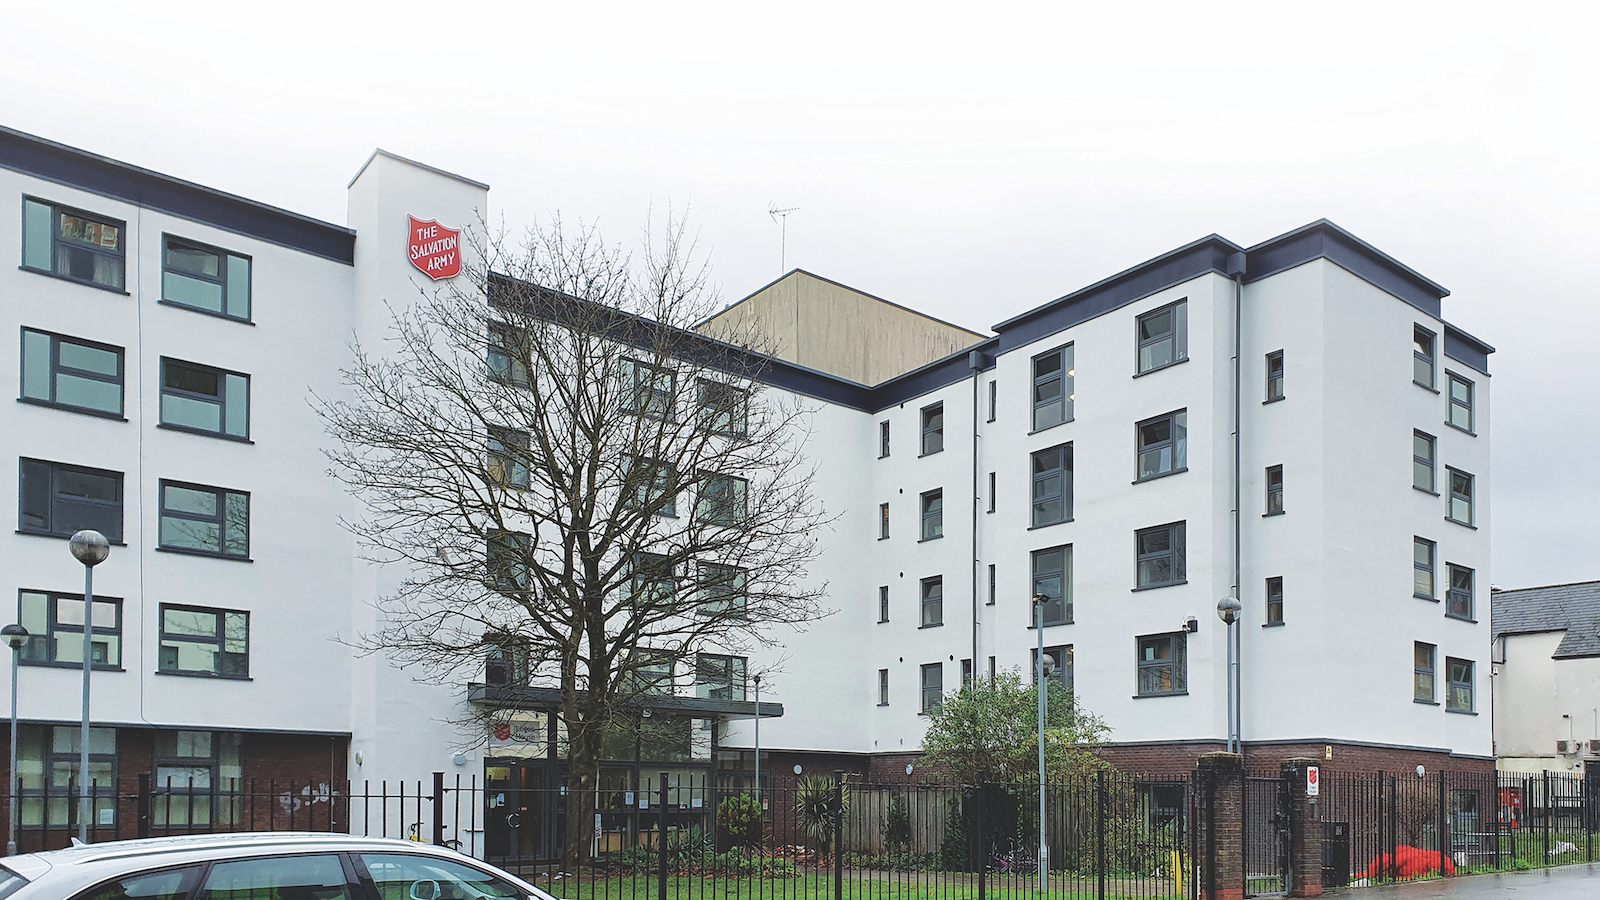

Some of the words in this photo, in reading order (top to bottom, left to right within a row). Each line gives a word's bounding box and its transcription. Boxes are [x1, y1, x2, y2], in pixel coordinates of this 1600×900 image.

[417, 226, 438, 241] THE
[411, 235, 457, 260] SALVATION
[427, 251, 455, 271] ARMY
